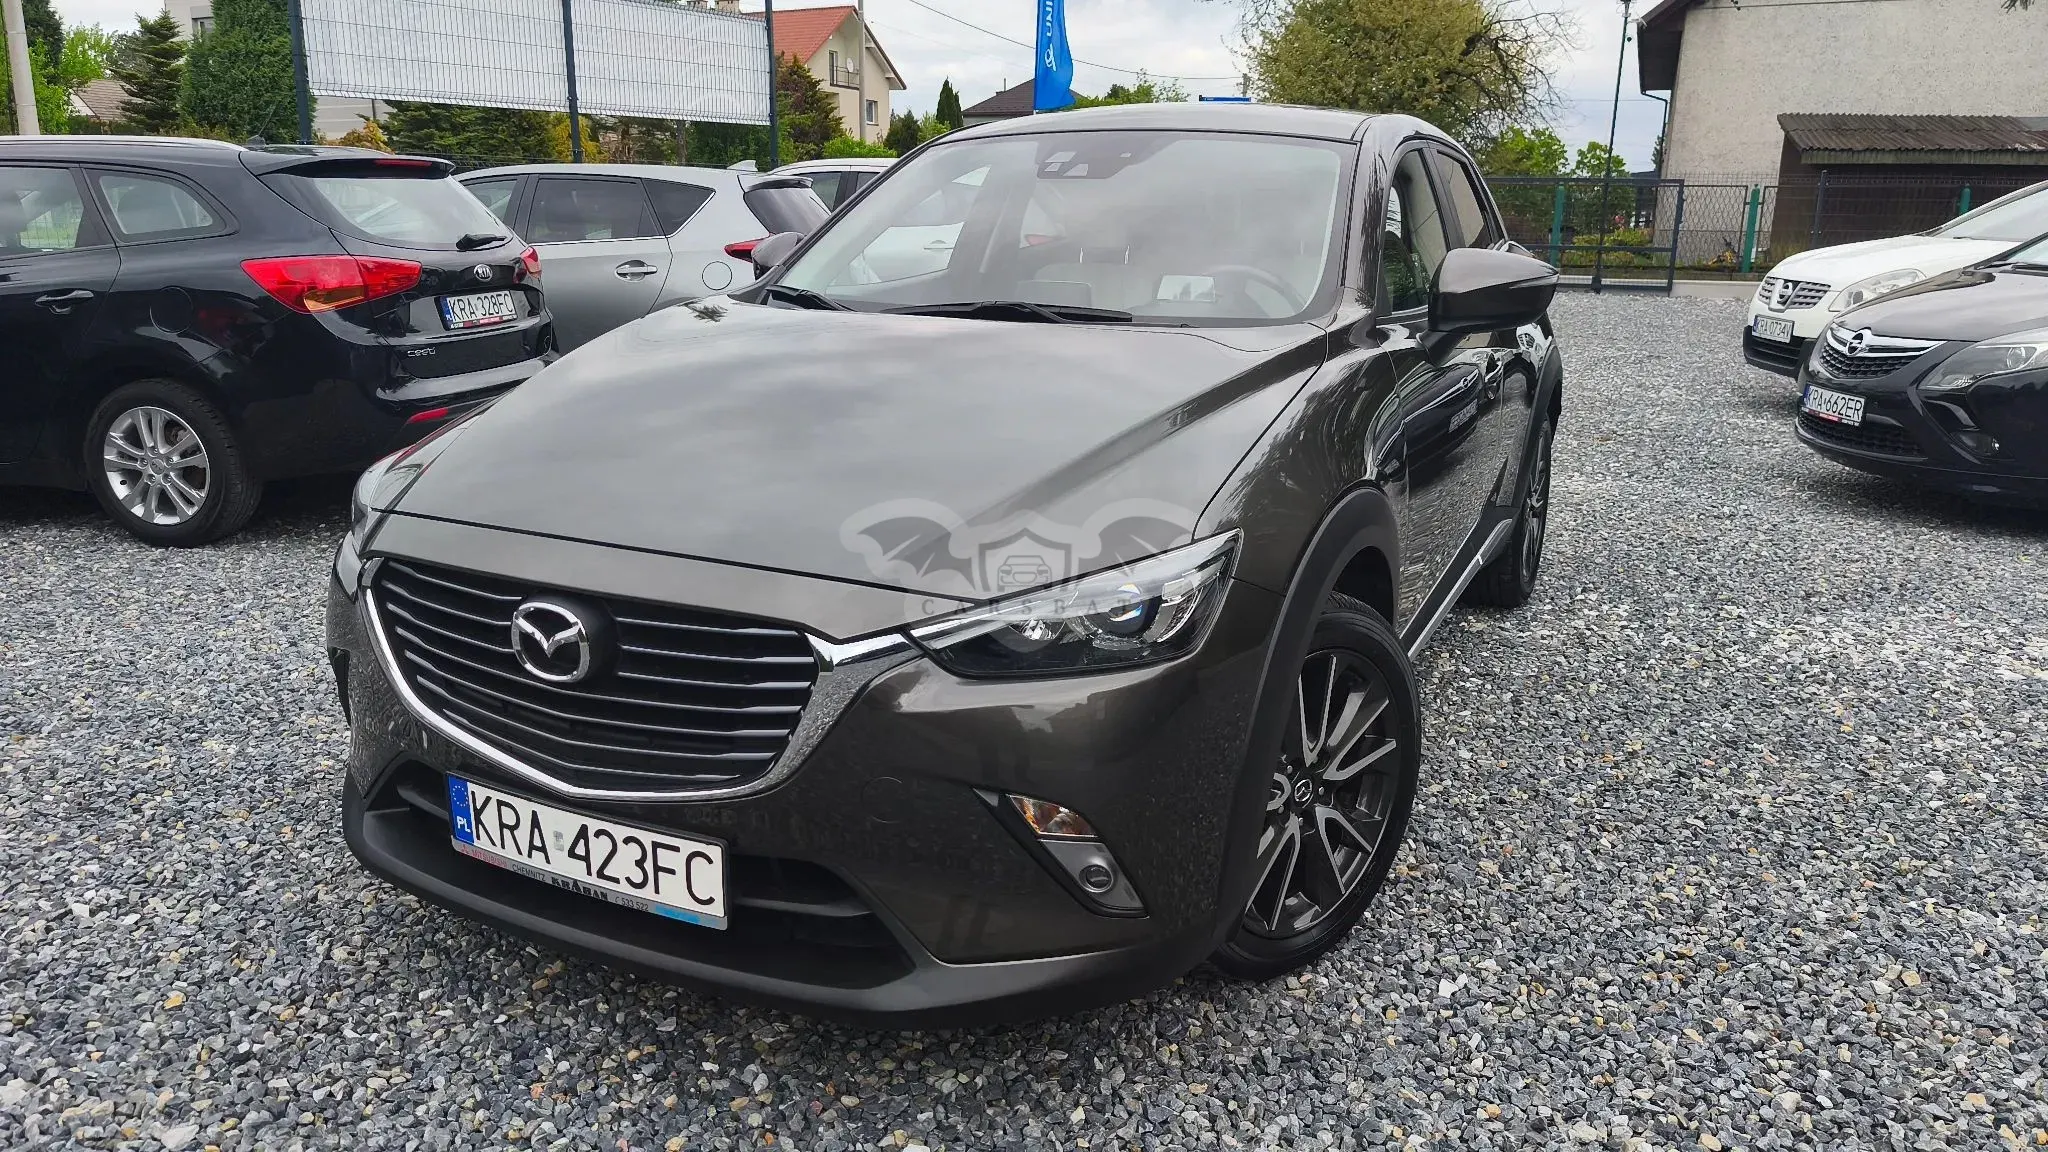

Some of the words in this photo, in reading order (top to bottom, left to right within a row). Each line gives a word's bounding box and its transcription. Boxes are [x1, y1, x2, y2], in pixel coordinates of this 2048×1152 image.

[477, 267, 491, 278] KIA
[449, 298, 477, 320] KRA
[477, 293, 513, 317] 328FC
[1807, 388, 1824, 410] KRA
[1825, 393, 1863, 421] 662ER
[457, 816, 471, 833] PL
[471, 790, 551, 865] KRA
[568, 823, 716, 906] 423FC
[512, 863, 545, 882] CHEMNITZ
